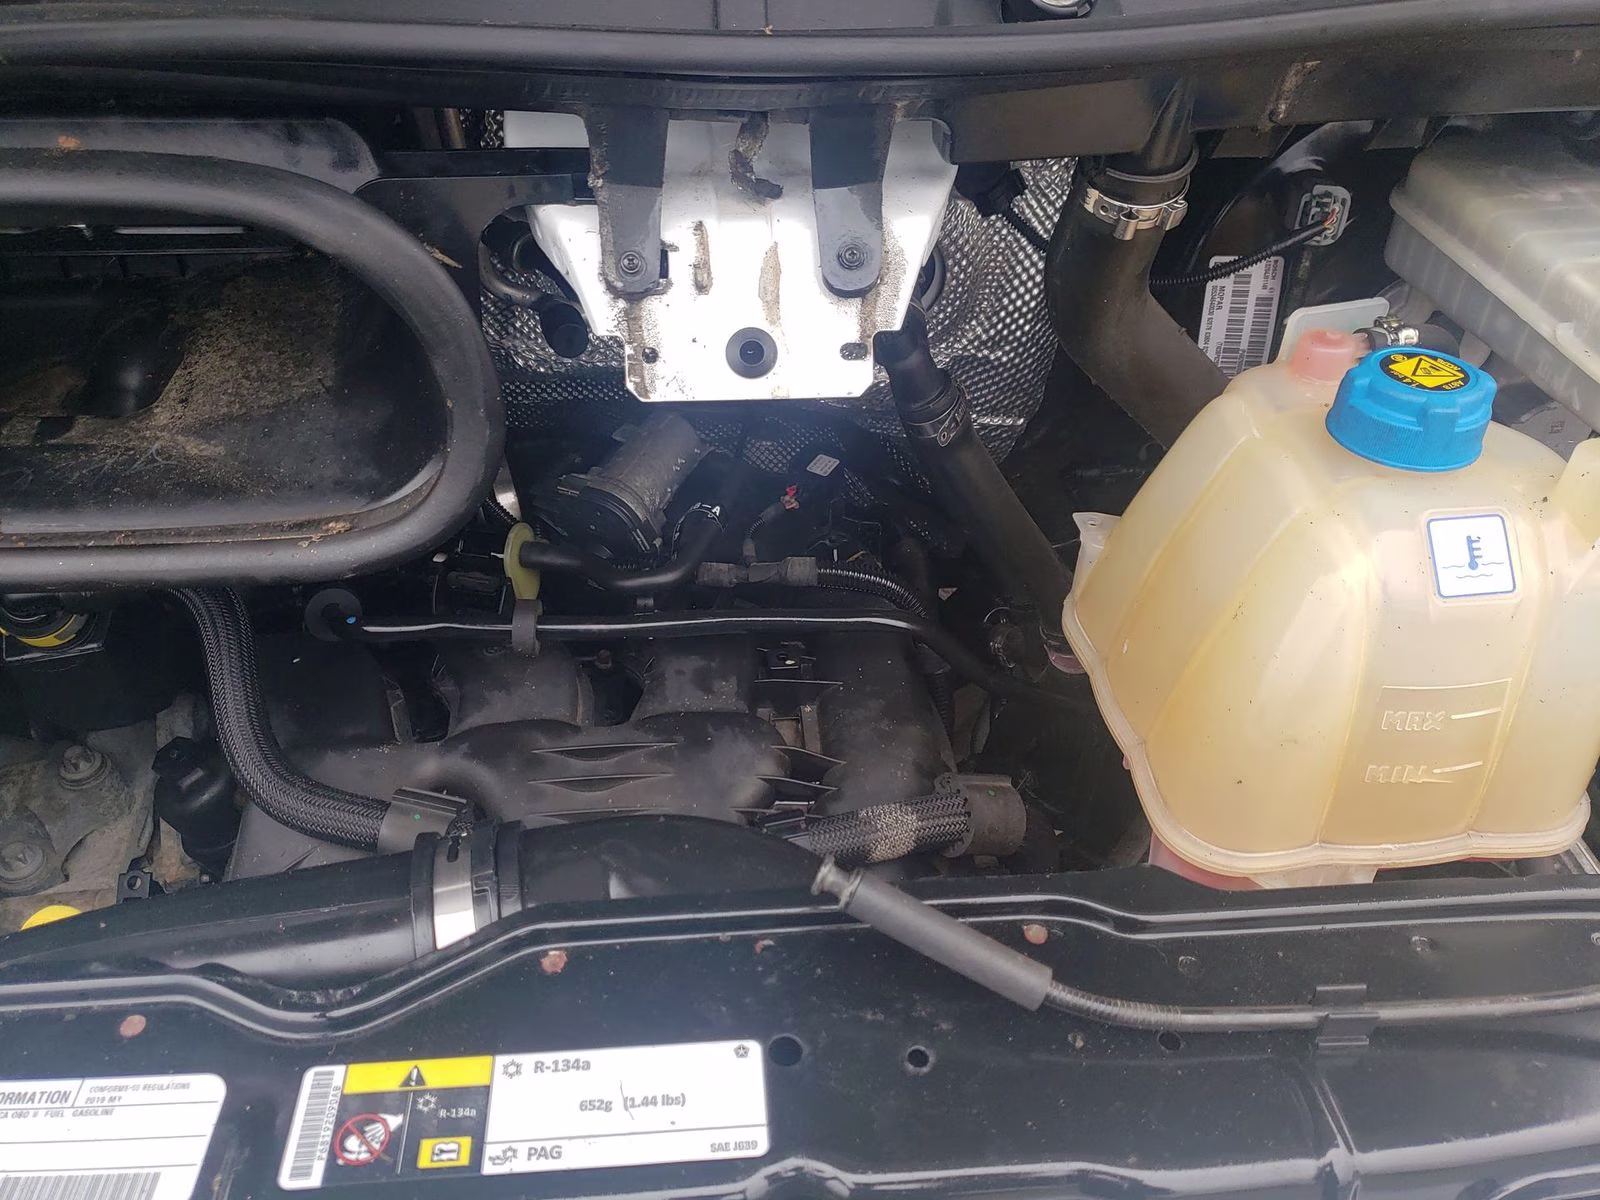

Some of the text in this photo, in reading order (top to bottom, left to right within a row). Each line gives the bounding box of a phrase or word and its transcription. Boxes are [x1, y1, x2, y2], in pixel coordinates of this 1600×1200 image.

[1215, 285, 1226, 311] MOPAR
[1380, 710, 1447, 732] MAX
[1364, 764, 1429, 784] MIN
[532, 1057, 591, 1074] R-134a
[579, 1092, 687, 1113] 652g (1.44 lbs)
[44, 1109, 65, 1118] FUEL
[72, 1107, 114, 1117] GASOLINE
[438, 1106, 477, 1119] R-134a
[526, 1144, 563, 1161] PAG
[710, 1140, 759, 1153] SAE J639
